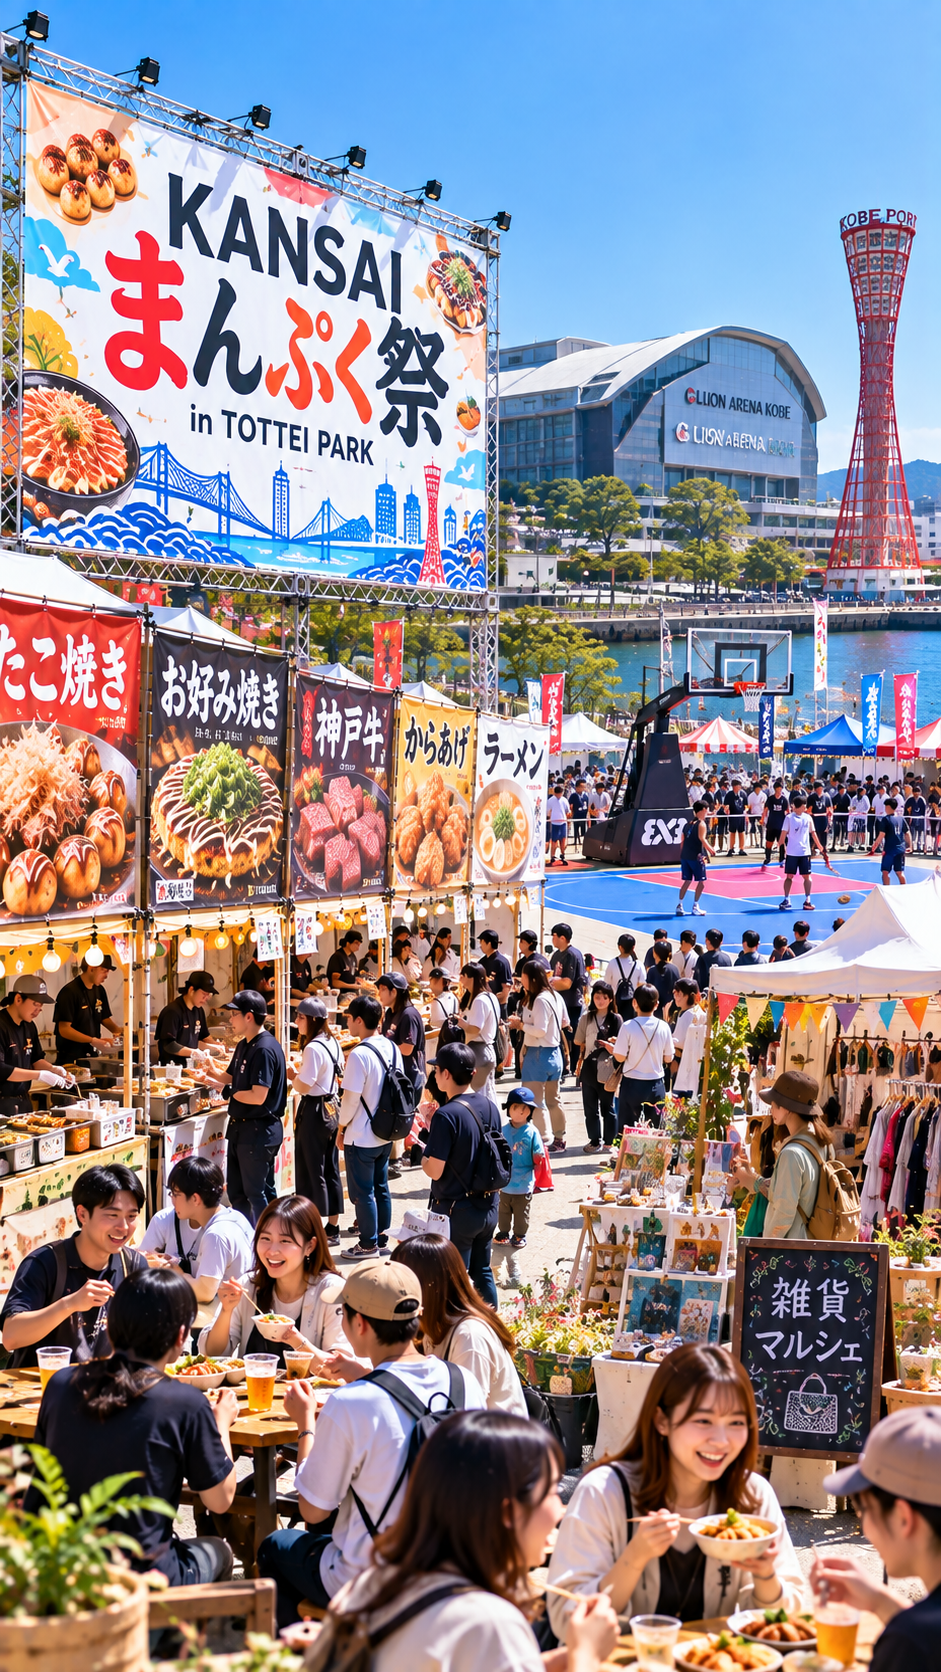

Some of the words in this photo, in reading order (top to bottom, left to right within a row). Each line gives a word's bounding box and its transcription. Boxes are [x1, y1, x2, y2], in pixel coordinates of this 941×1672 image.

[168, 172, 401, 315] KANSAI
[840, 208, 881, 232] KOBE
[104, 230, 449, 447] まんぷく祭
[190, 403, 212, 435] in
[221, 409, 308, 453] TOTTEI
[318, 429, 374, 466] PARK
[729, 396, 763, 416] ARENA
[765, 402, 791, 420] KOBE
[161, 654, 279, 730] お好み焼き
[315, 697, 384, 763] 神戸牛
[404, 715, 471, 770] からあげ
[484, 732, 544, 780] ラーメン
[771, 1276, 849, 1323] 雑貨
[755, 1330, 863, 1362] マルシェ
